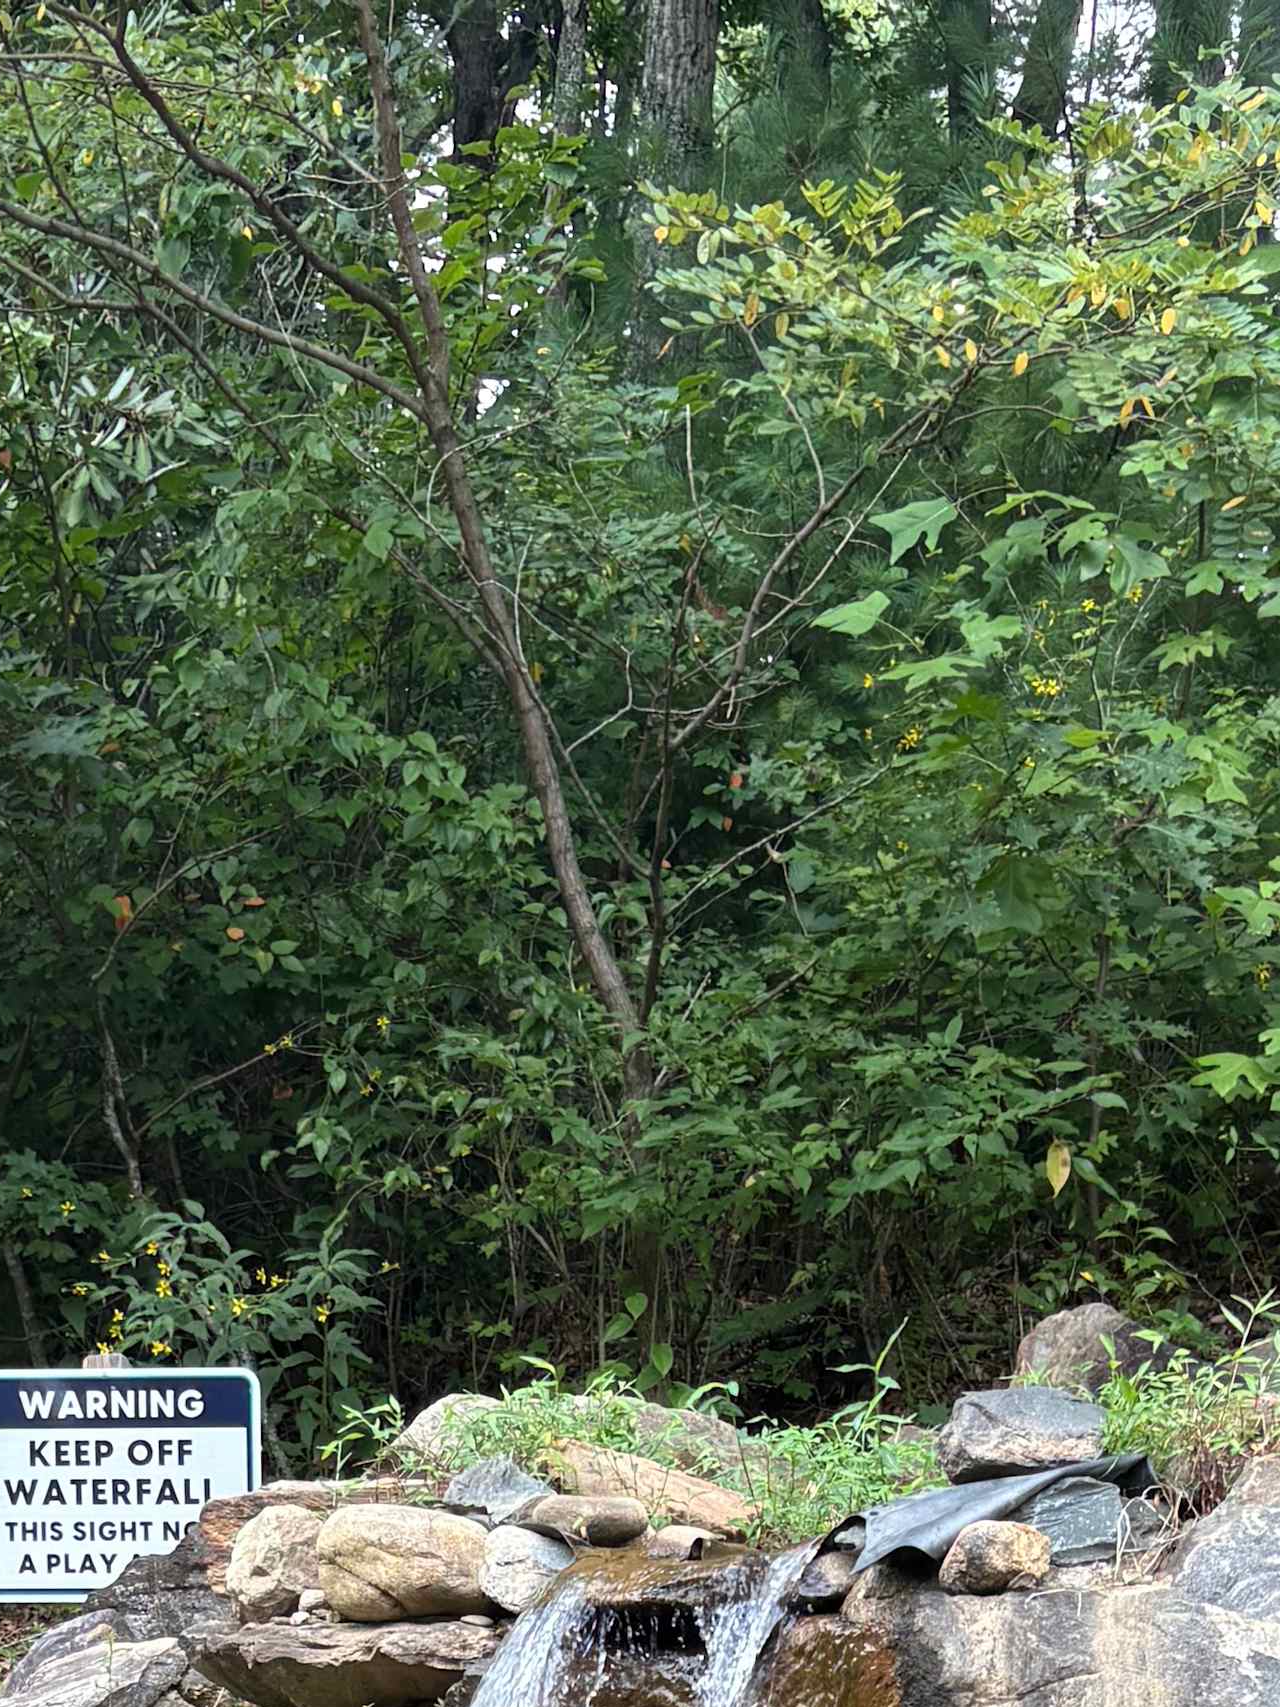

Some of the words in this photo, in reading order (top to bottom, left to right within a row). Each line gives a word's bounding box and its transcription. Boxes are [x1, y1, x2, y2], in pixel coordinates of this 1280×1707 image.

[19, 1388, 205, 1419] WARNING
[29, 1439, 114, 1467] KEEP
[127, 1439, 193, 1466] OFF
[5, 1521, 63, 1541] THIS
[73, 1521, 153, 1541] SIGHT
[19, 1554, 37, 1574] A
[47, 1553, 118, 1574] PLAY
